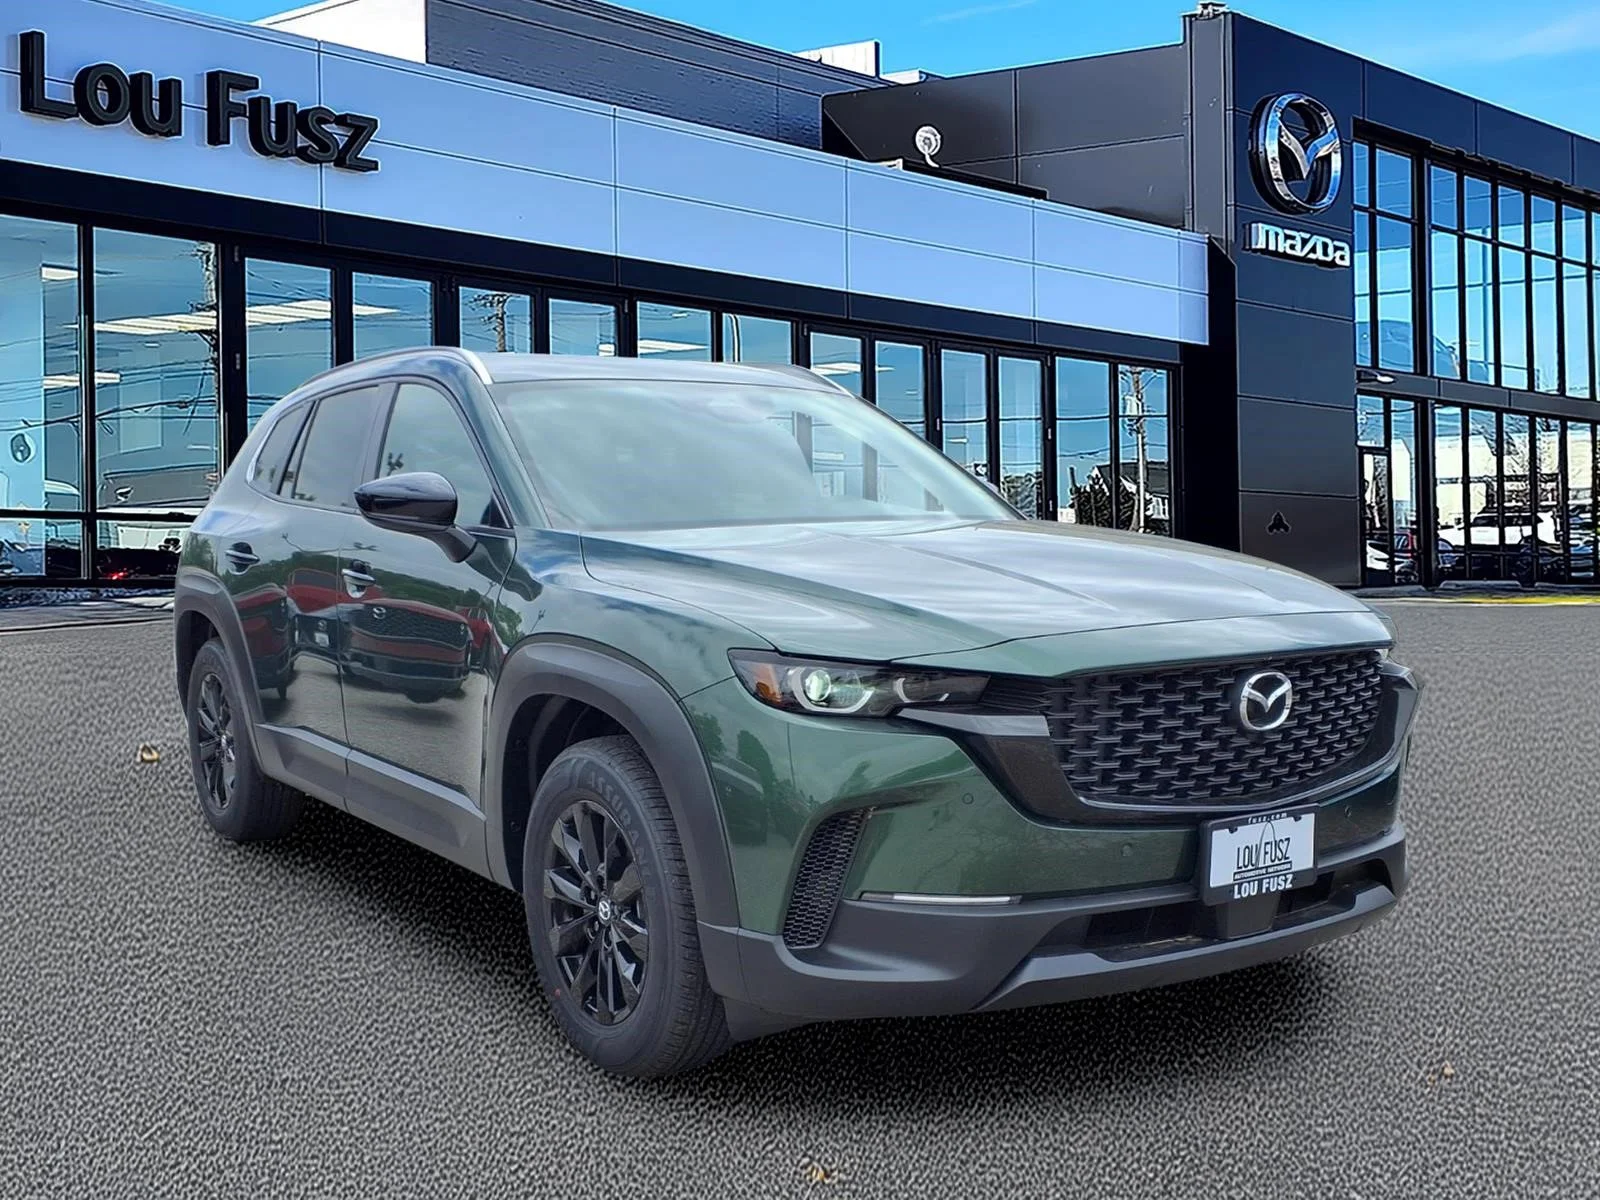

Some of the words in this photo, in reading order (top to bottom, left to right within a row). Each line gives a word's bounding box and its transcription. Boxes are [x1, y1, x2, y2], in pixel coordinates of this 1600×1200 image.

[20, 30, 182, 138] Lou
[206, 70, 380, 172] Fusz
[1251, 222, 1351, 267] mazda
[1248, 813, 1287, 824] fusz.com
[1237, 844, 1259, 869] LOU
[1263, 838, 1290, 865] FUSZ
[1234, 881, 1258, 899] LOU
[1262, 875, 1293, 893] FUSZ
